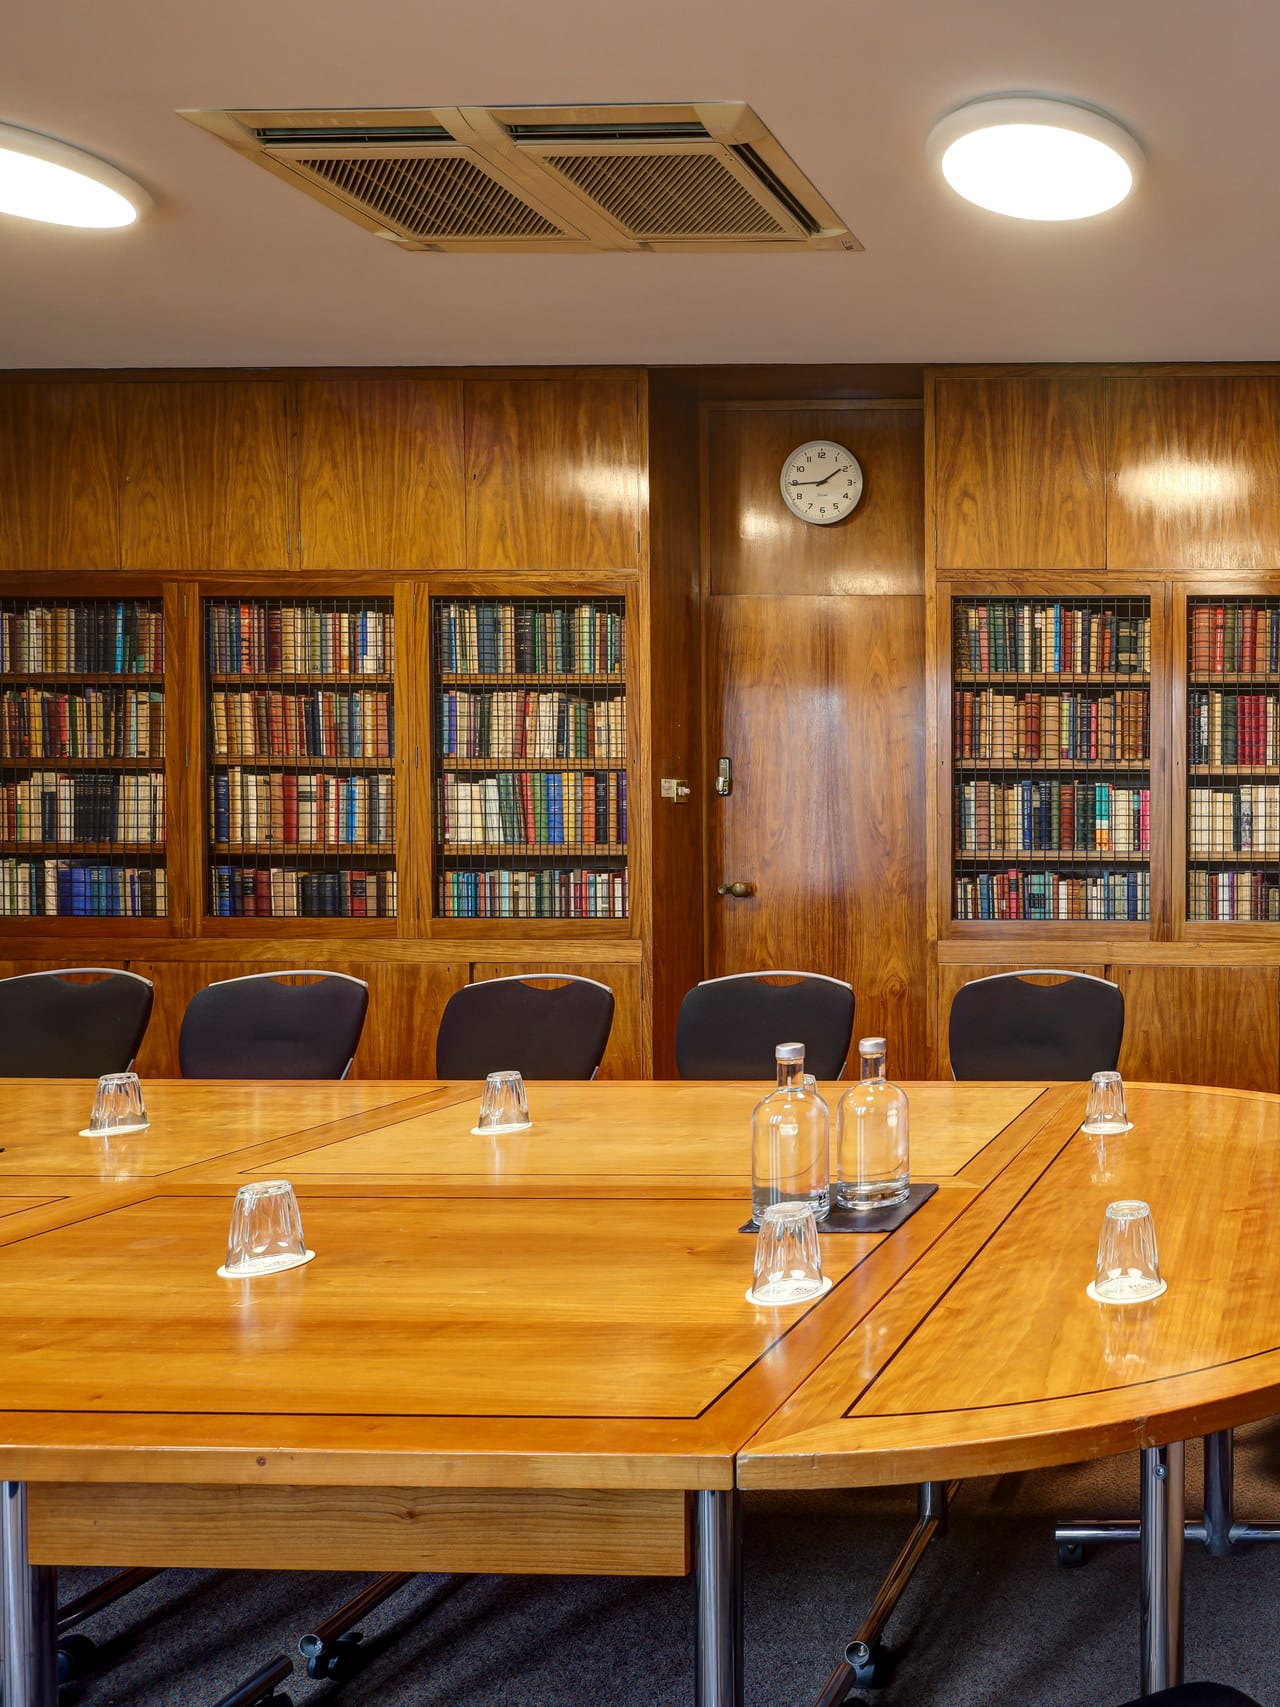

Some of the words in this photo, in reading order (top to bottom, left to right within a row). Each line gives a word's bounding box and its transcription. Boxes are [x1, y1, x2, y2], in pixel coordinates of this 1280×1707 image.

[817, 451, 826, 459] 12
[796, 465, 805, 473] 10
[807, 502, 813, 510] 7
[819, 506, 826, 514] 6
[832, 502, 839, 510] 5
